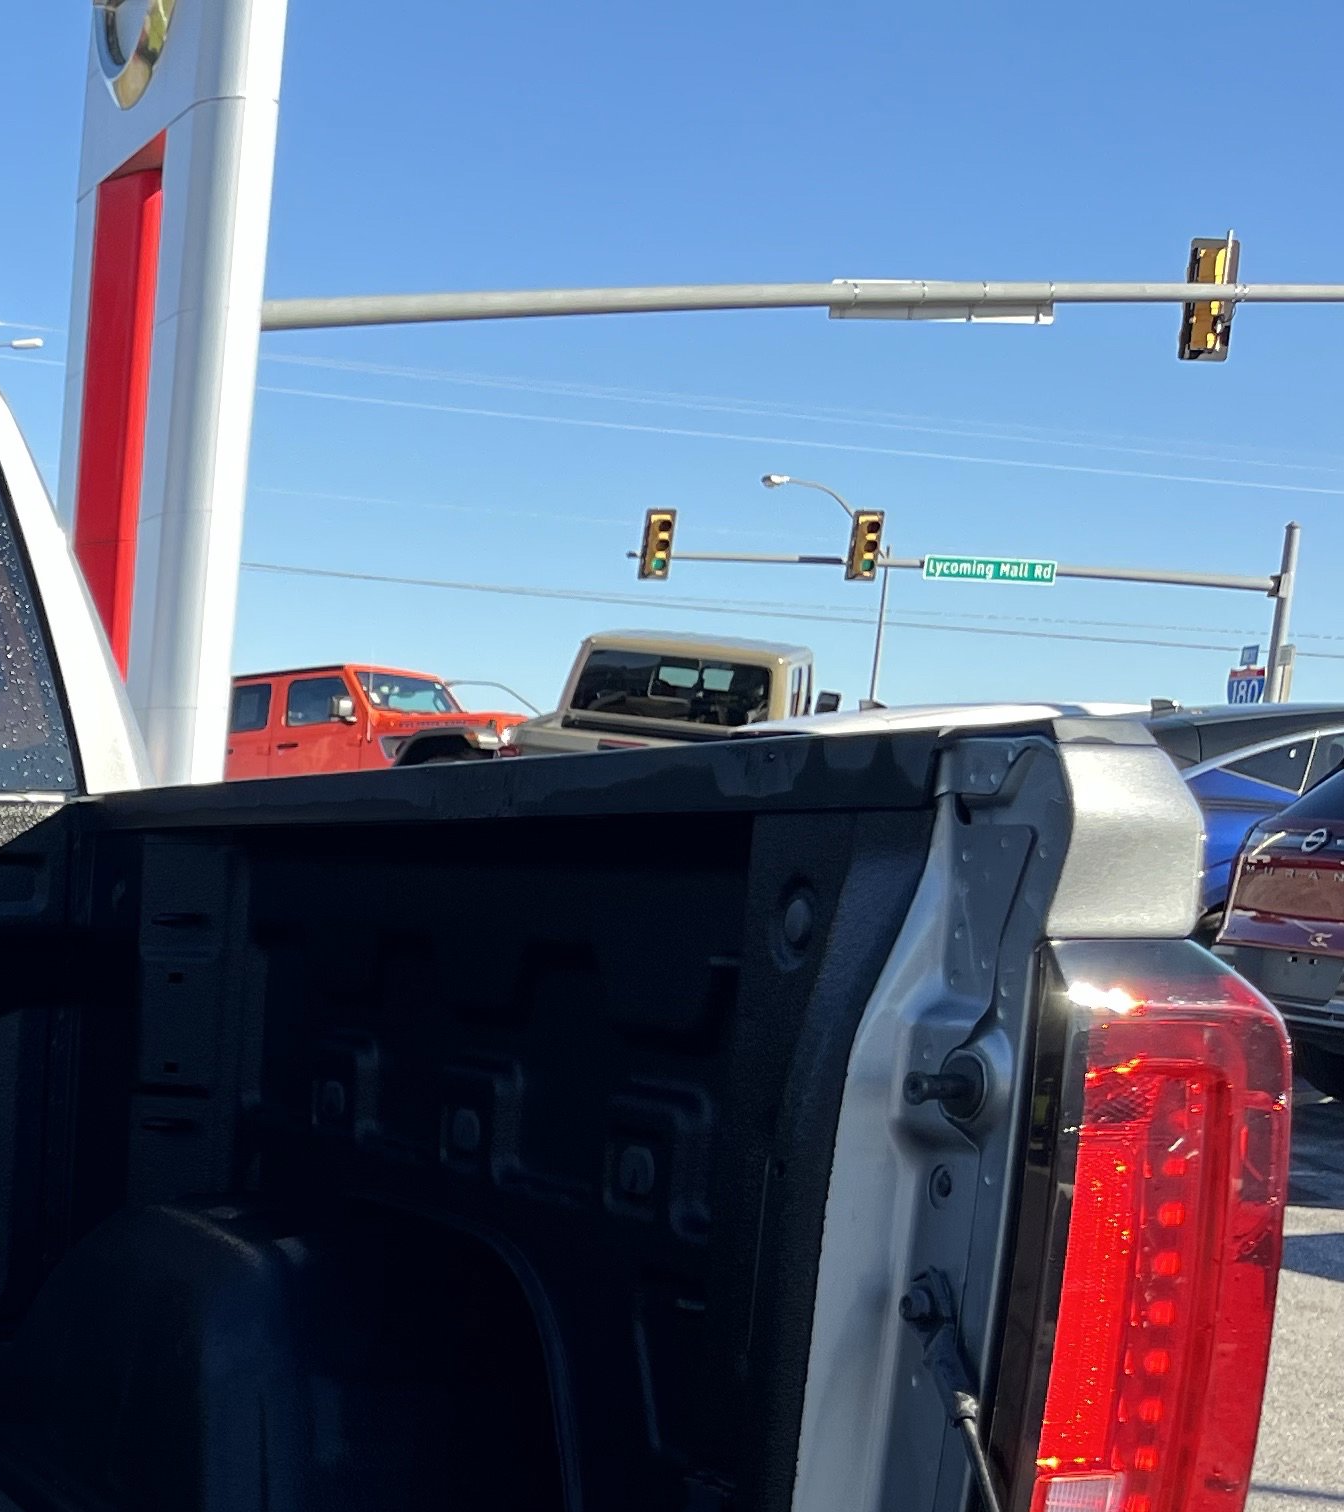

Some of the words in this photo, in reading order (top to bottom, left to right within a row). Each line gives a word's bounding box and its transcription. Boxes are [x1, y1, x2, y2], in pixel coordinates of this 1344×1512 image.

[929, 560, 994, 580] Lycoming
[999, 562, 1028, 578] Mall
[1034, 564, 1052, 579] Rd
[1232, 680, 1258, 703] 180
